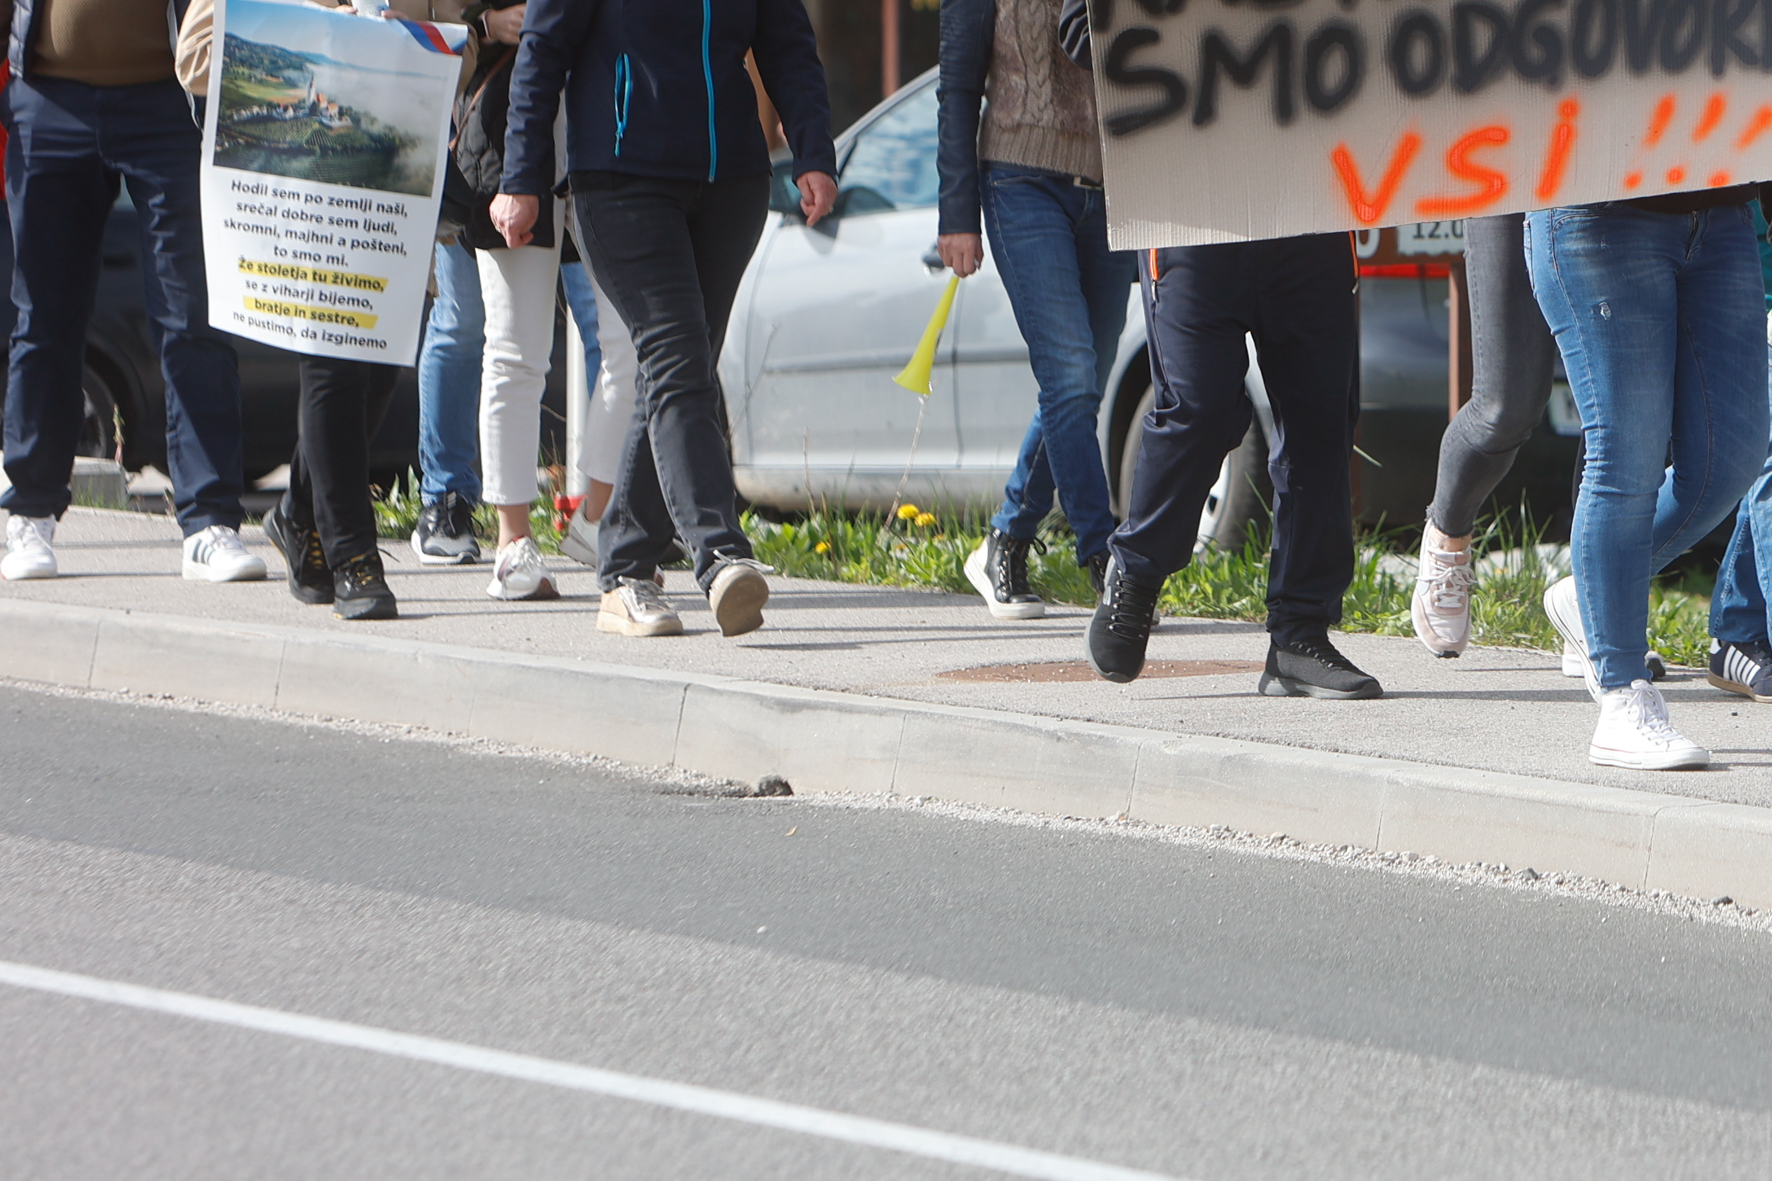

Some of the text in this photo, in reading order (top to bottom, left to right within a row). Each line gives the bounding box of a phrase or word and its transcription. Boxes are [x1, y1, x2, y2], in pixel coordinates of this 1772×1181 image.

[1106, 21, 1364, 136] SMO
[231, 179, 408, 218] Hodil sem po zemlji naši,
[223, 218, 407, 256] skromni, majhni a pošteni,
[236, 201, 398, 236] srečal dobre sem ljudi,
[238, 255, 385, 292] Že stoletja tu živimo,
[273, 244, 349, 266] to smo mi.
[245, 278, 374, 310] se z viharji bijemo,
[233, 310, 388, 350] ne pustimo, da izginemo
[254, 298, 360, 328] bratje in sestre,
